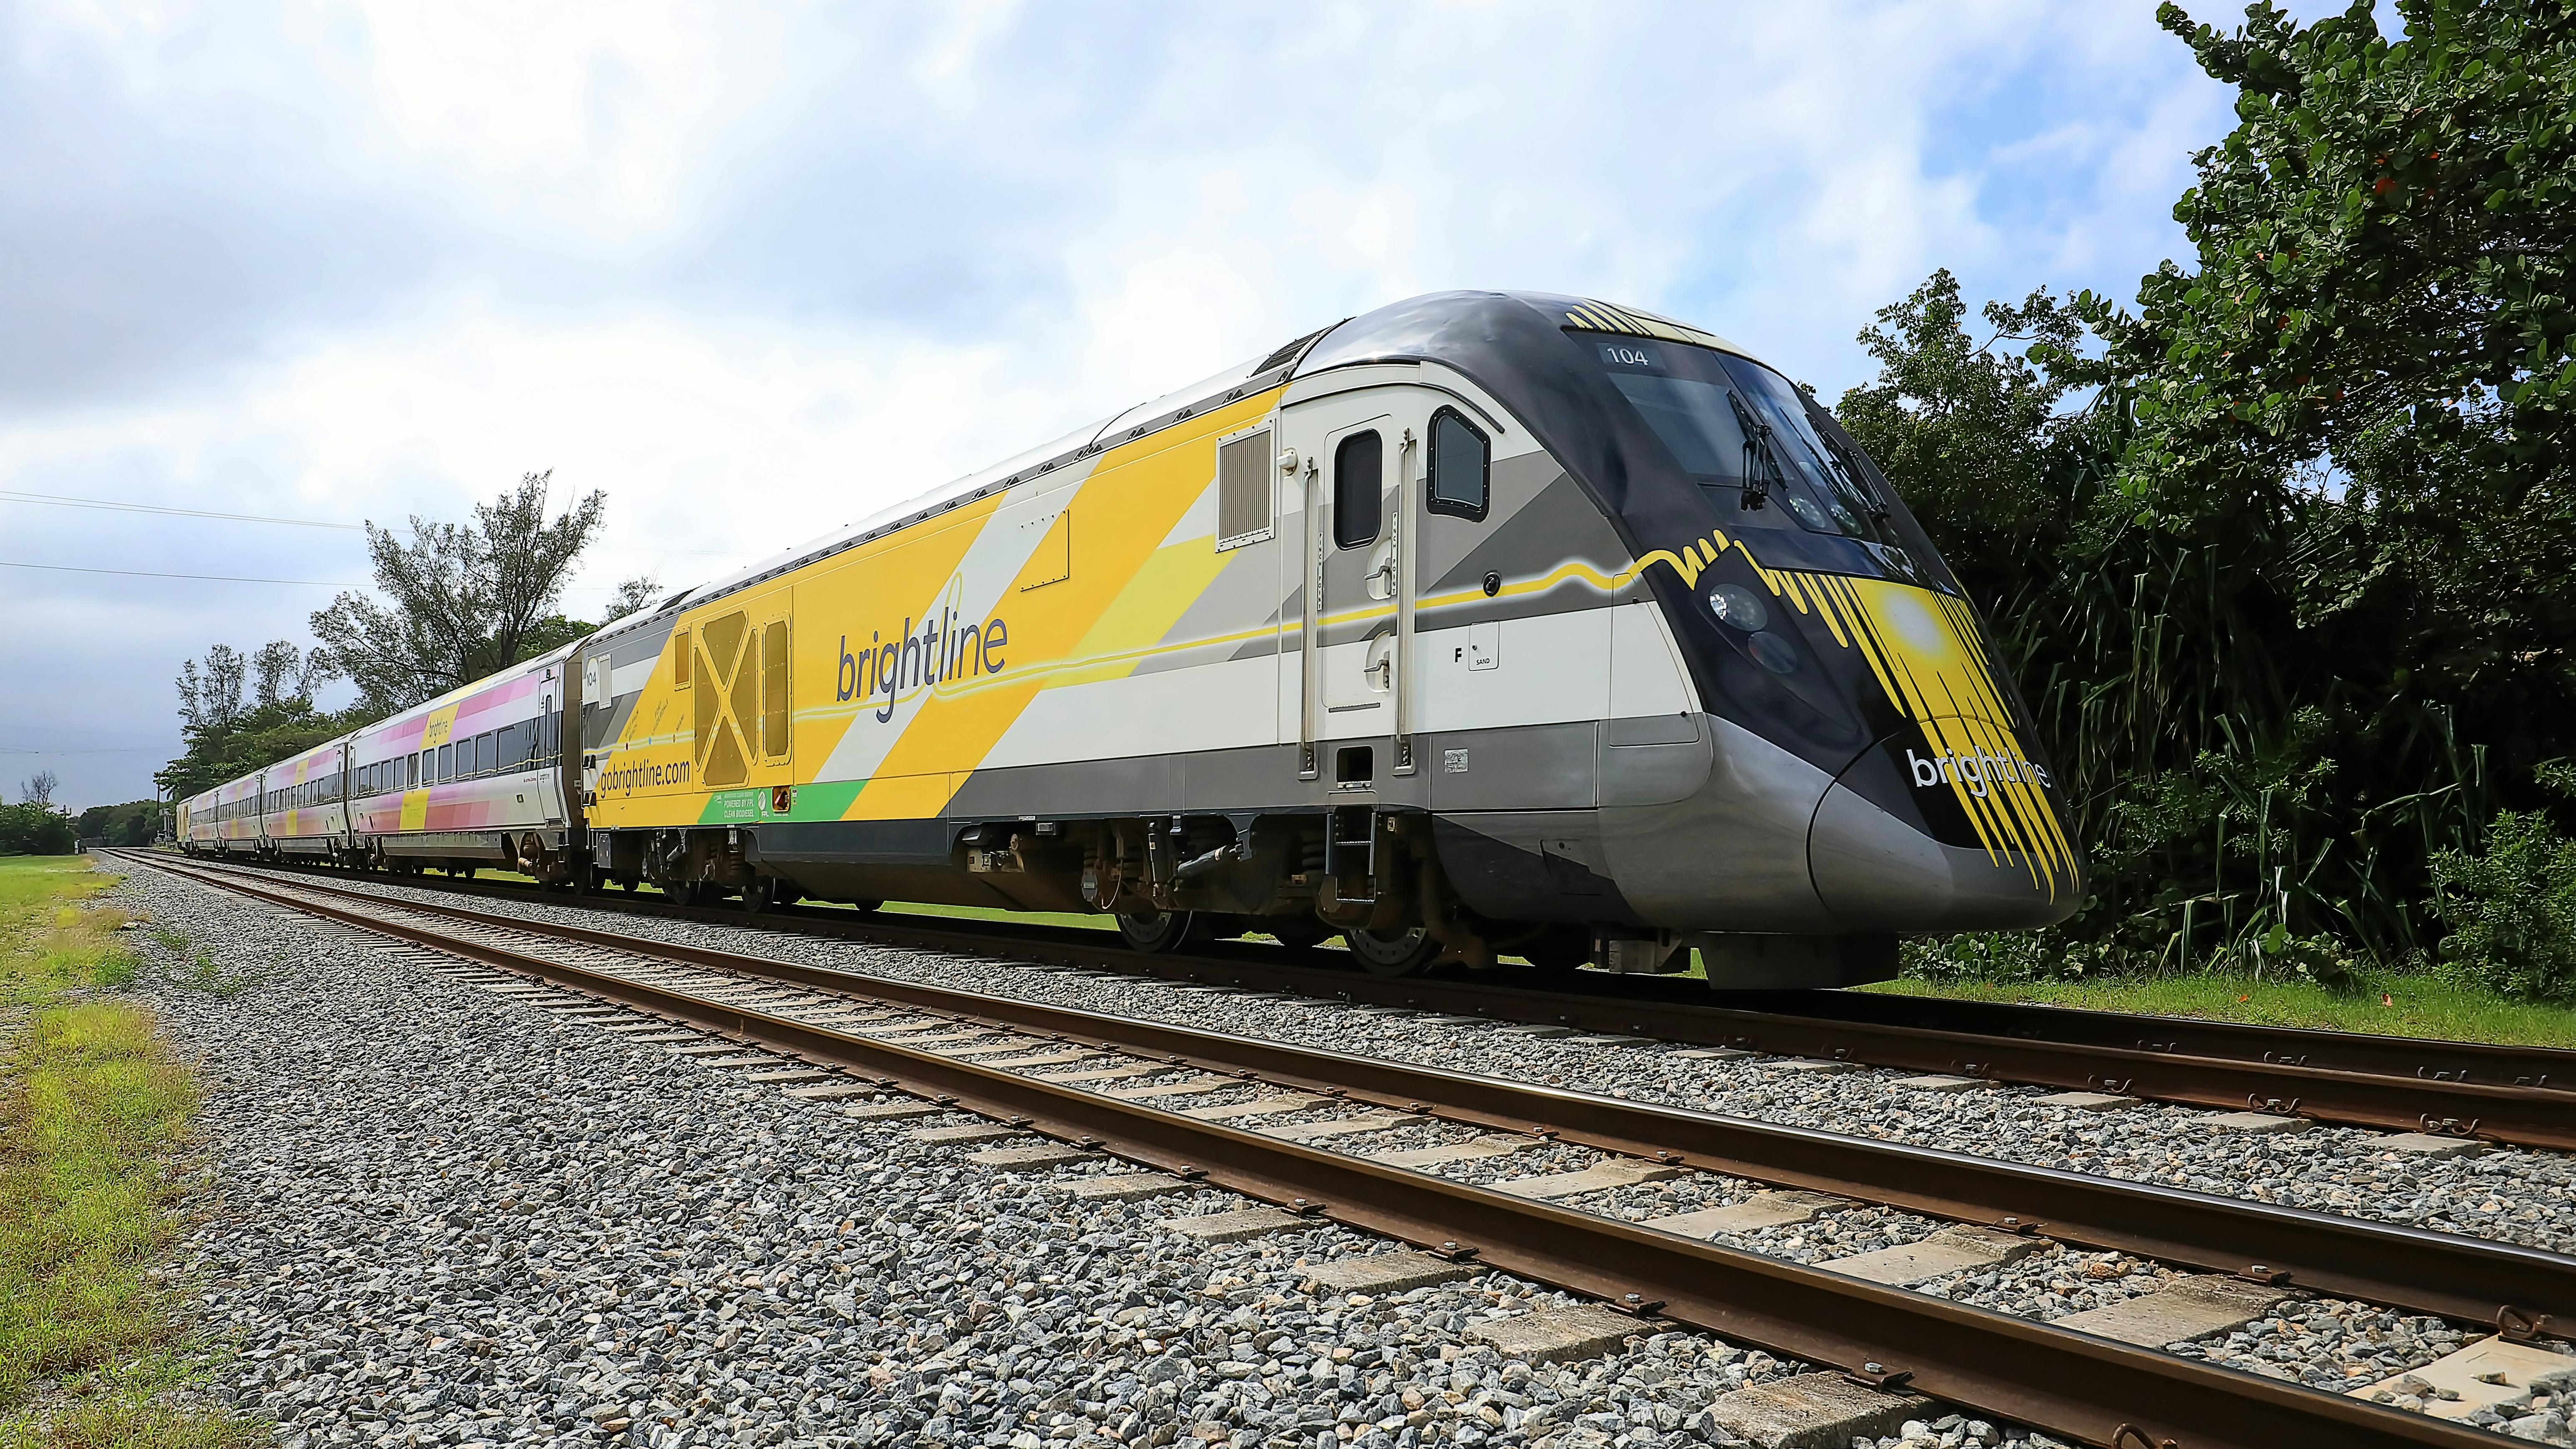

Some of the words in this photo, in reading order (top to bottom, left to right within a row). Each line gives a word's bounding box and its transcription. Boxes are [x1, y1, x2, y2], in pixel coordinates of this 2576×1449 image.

[1607, 347, 1649, 366] 104
[1455, 648, 1462, 663] F
[837, 607, 1007, 723] brightline
[587, 671, 596, 687] 104
[601, 758, 690, 799] gobrightline.com
[1906, 745, 2051, 797] brightline
[724, 799, 741, 808] POWERED
[741, 799, 747, 808] BY
[724, 810, 735, 818] CLEAN
[736, 809, 754, 818] BIODIESEL
